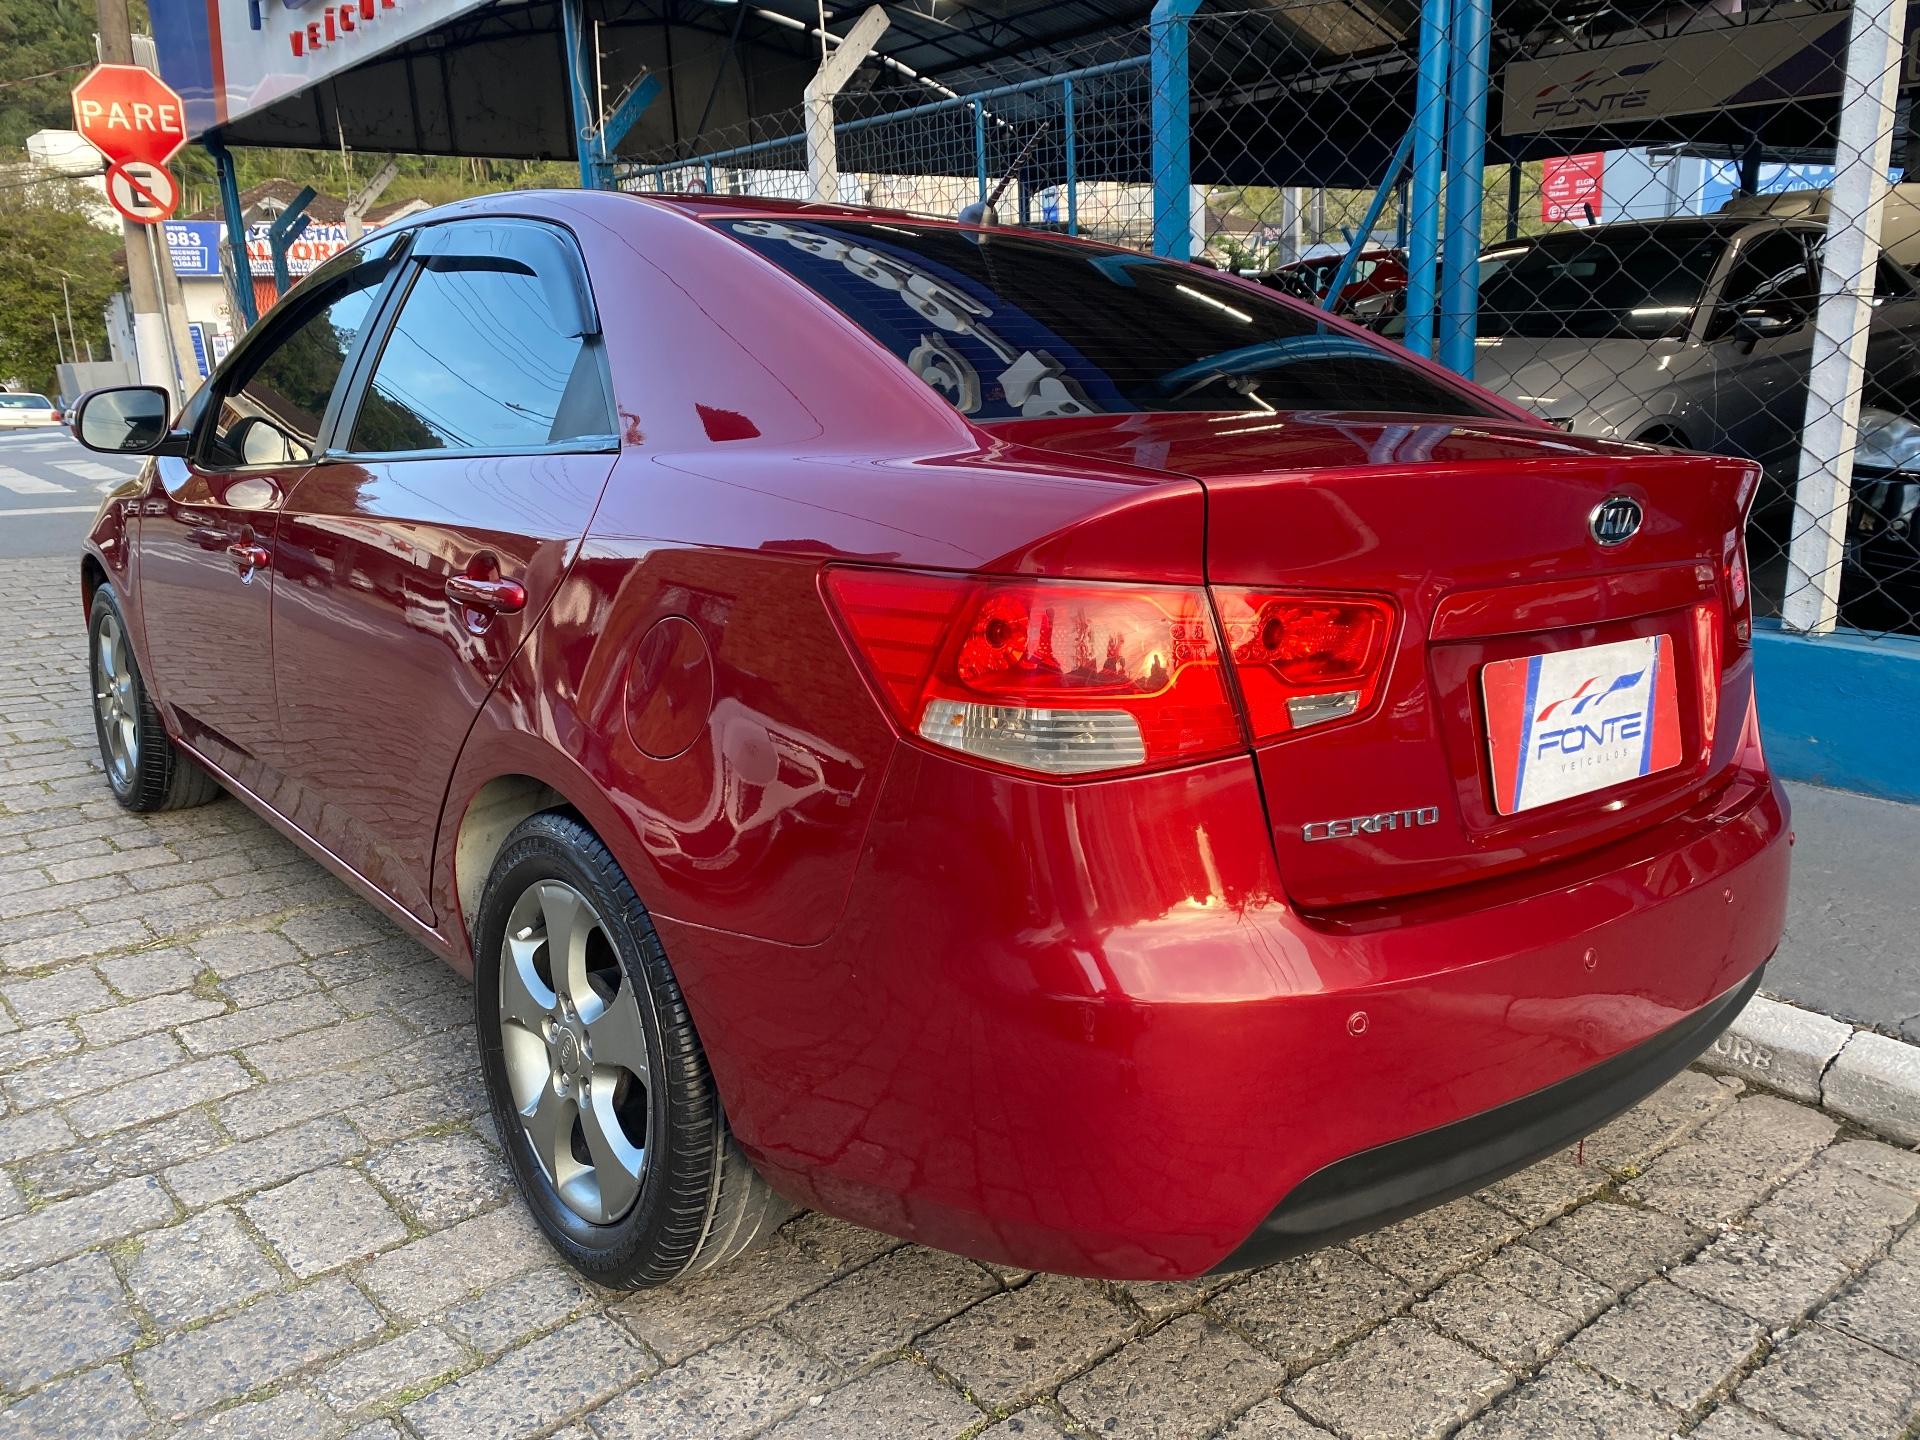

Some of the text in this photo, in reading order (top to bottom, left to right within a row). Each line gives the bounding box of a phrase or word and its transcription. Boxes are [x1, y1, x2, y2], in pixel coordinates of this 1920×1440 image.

[80, 99, 181, 133] PARE
[1532, 89, 1651, 119] FONTE
[1600, 507, 1636, 535] KIA
[1538, 711, 1642, 761] FONTE
[1301, 806, 1439, 843] CERATO
